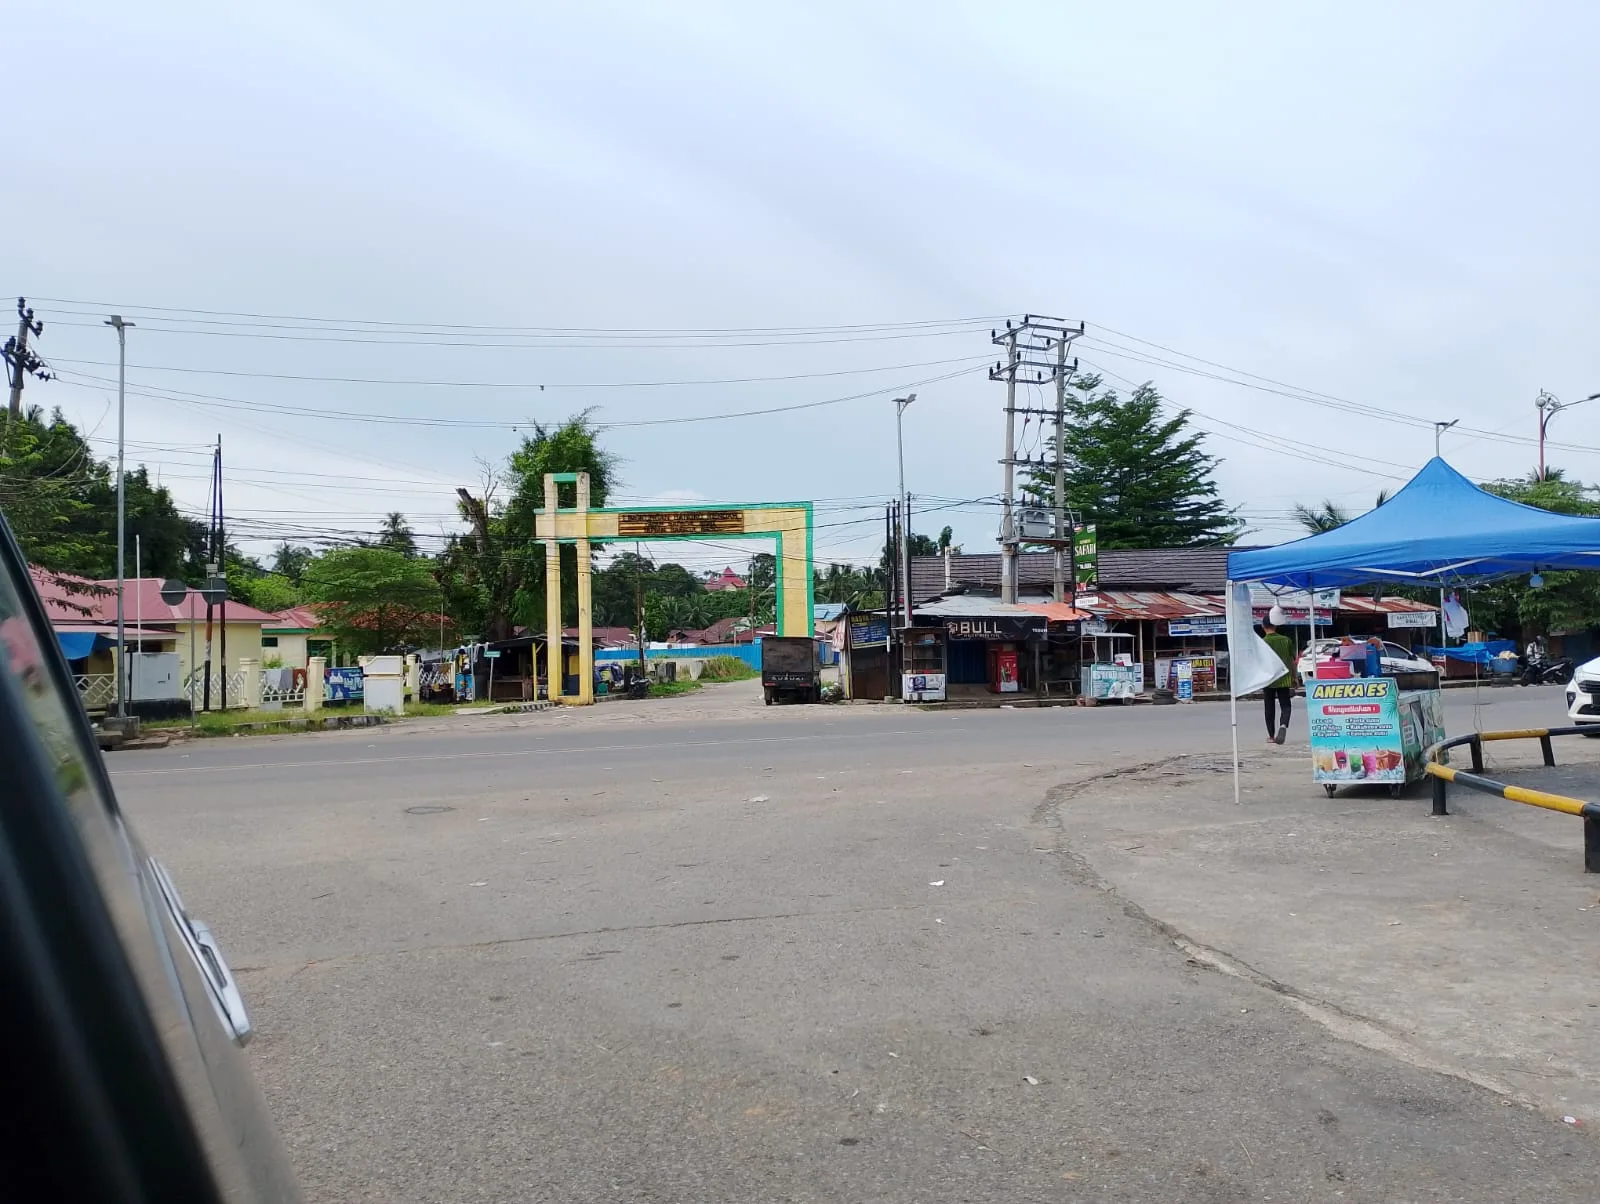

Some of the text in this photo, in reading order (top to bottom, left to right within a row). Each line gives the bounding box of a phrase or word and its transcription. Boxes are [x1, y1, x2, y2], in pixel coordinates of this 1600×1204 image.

[960, 621, 1002, 634] BULL
[1313, 682, 1388, 699] ANEKA ES
